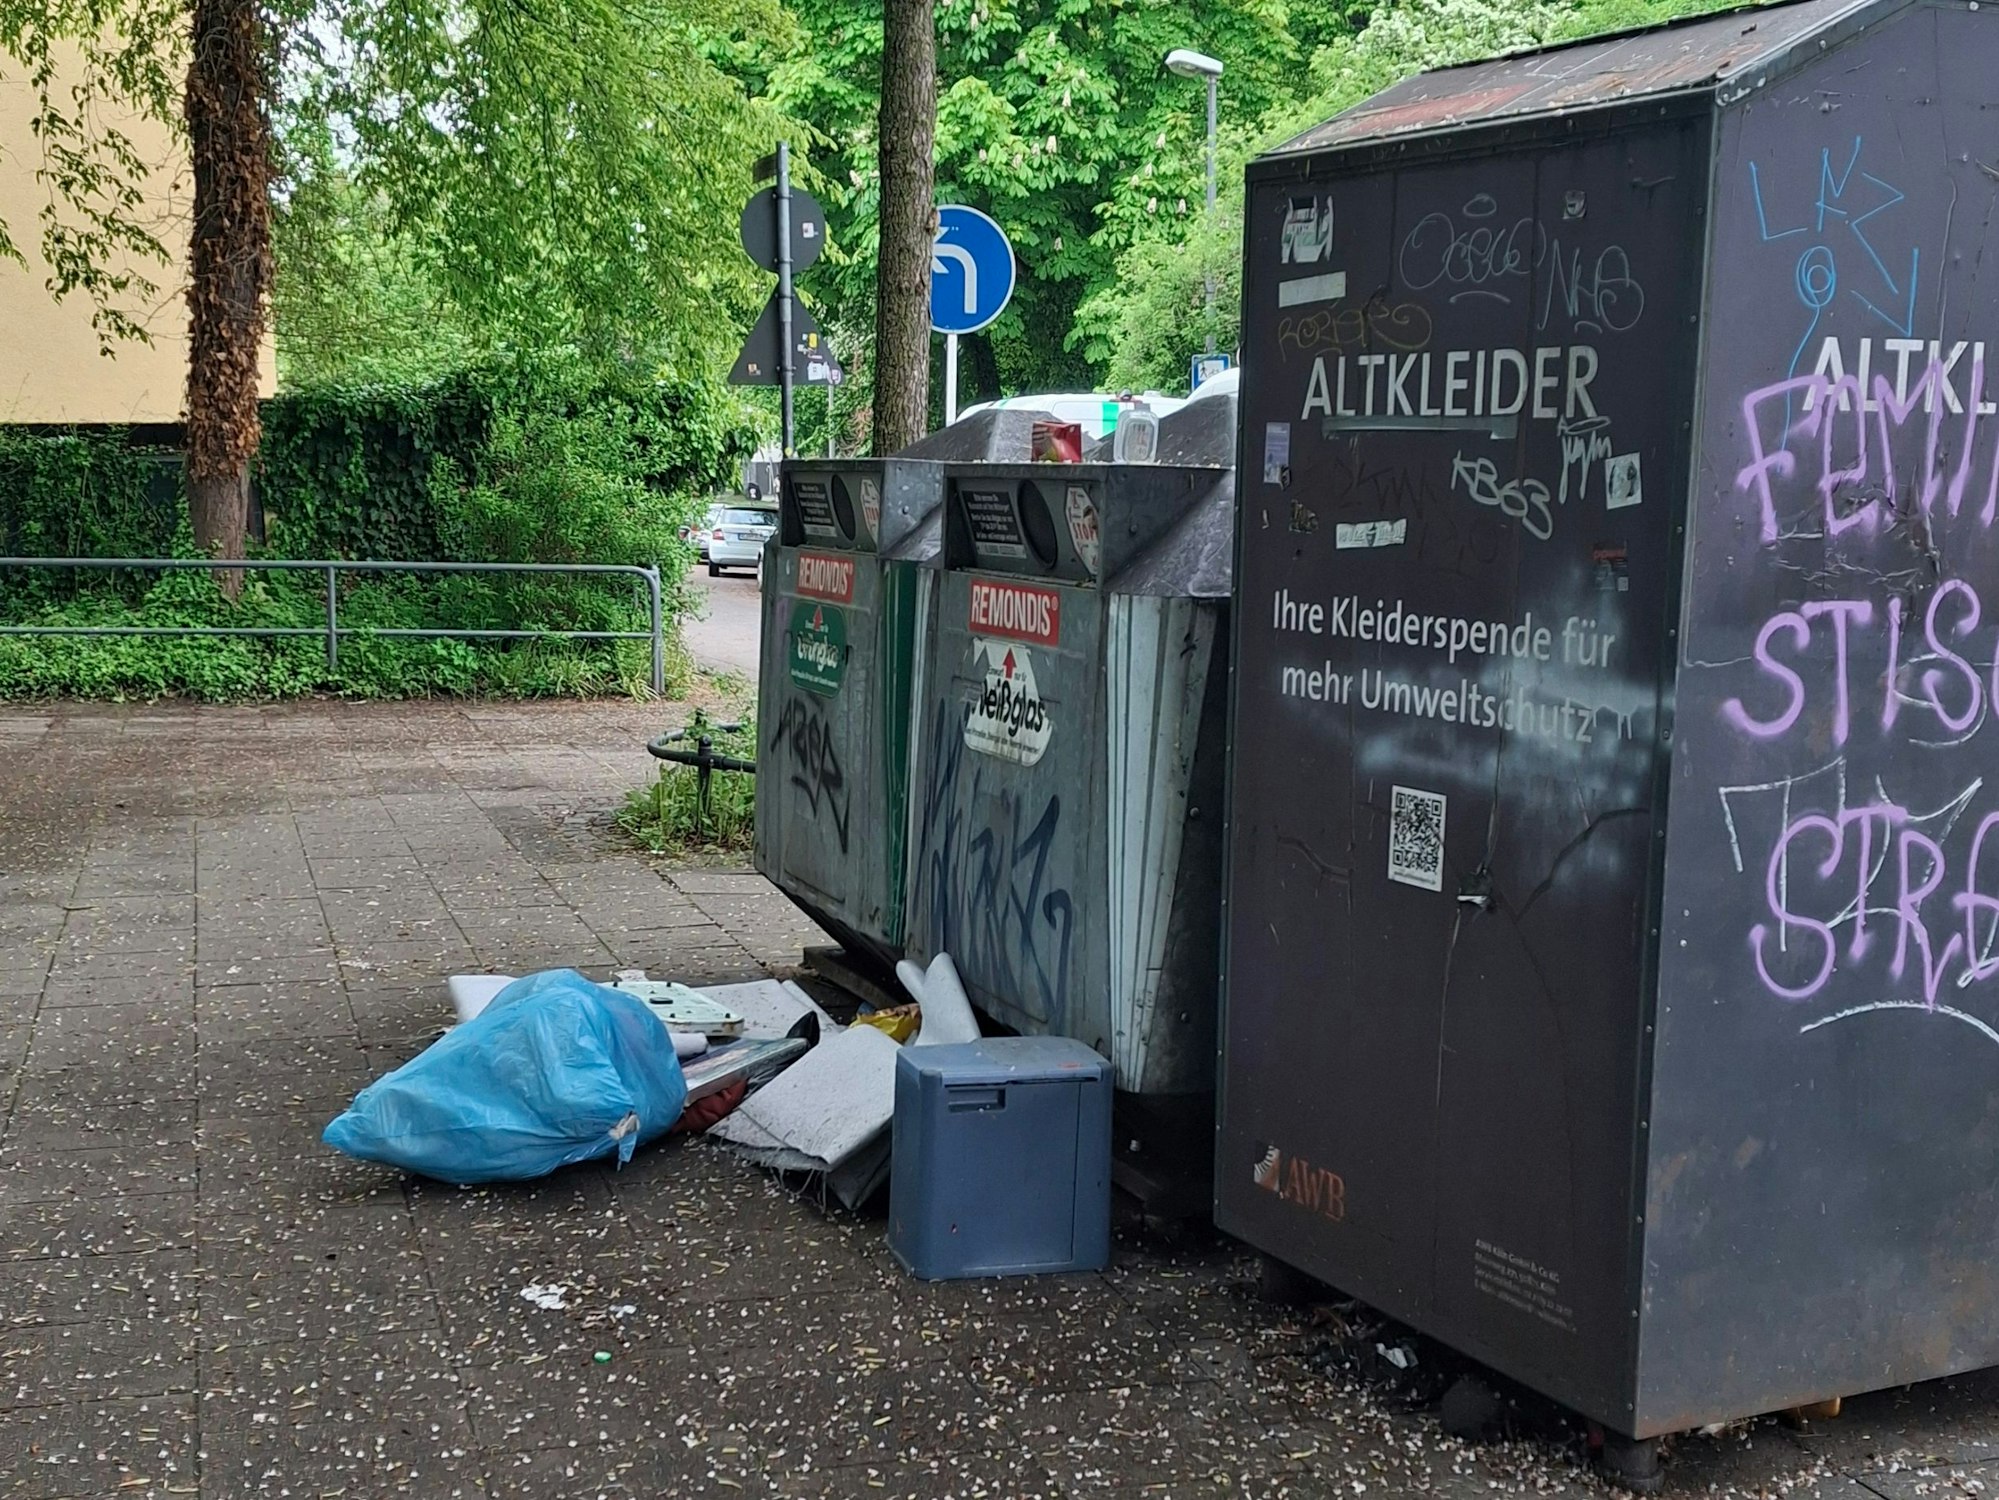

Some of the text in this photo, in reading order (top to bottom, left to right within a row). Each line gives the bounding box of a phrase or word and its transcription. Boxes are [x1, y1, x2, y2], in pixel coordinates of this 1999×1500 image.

[1301, 345, 1599, 421] ALTKLEIDER
[1273, 589, 1617, 668] Ihre Kleiderspende für
[1281, 660, 1593, 744] mehr Umweltschutz
[1284, 1157, 1345, 1221] AWB
